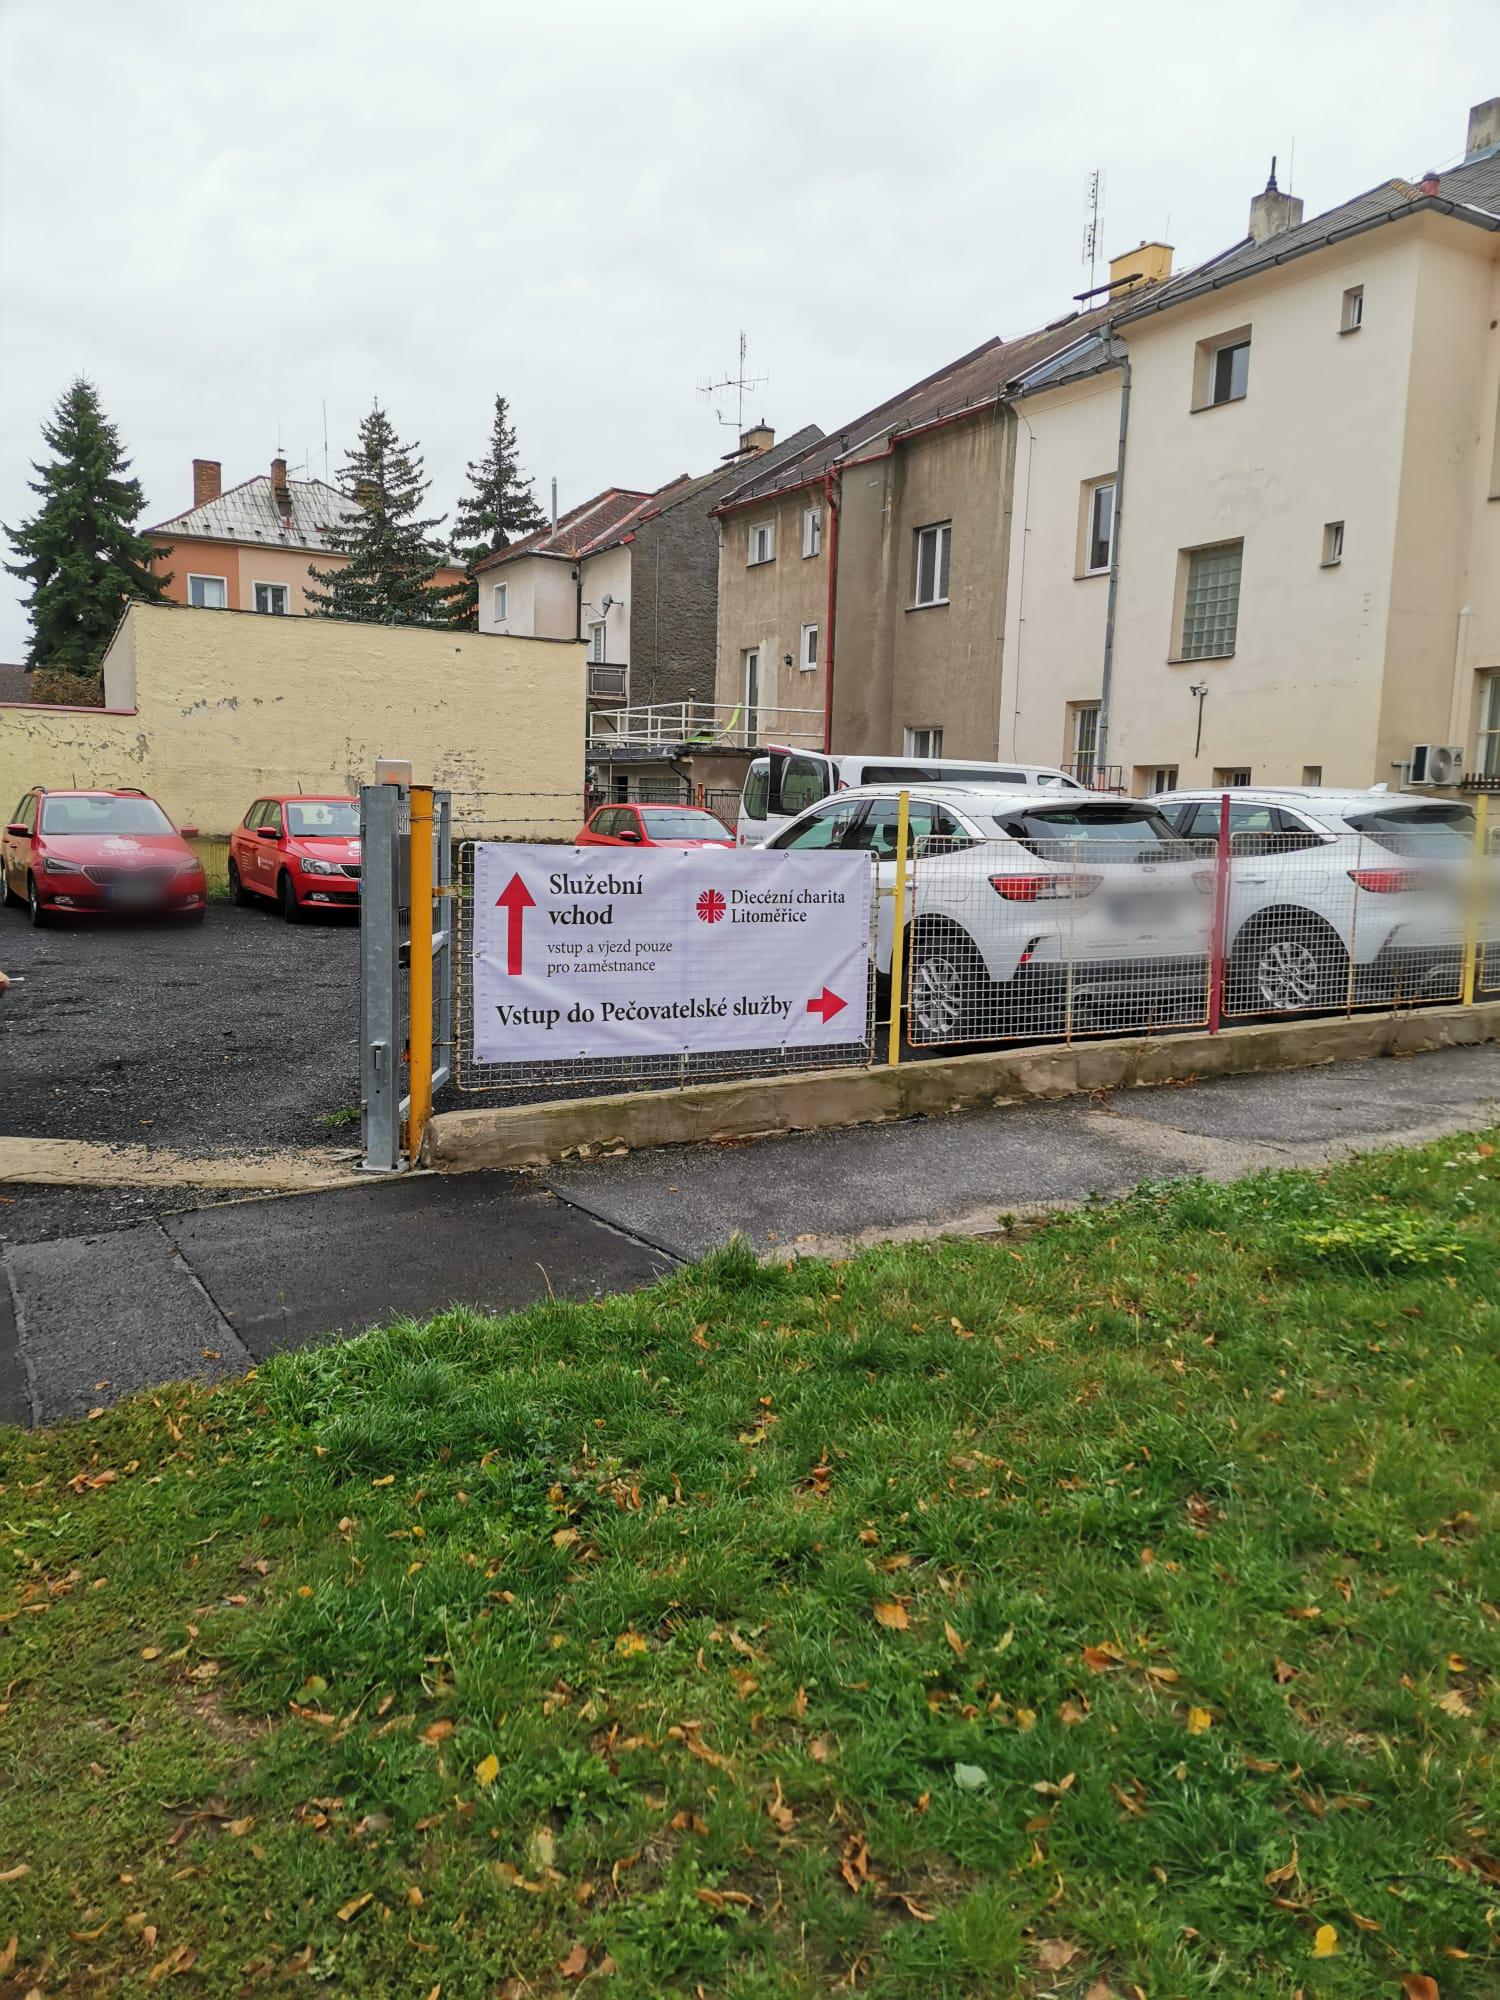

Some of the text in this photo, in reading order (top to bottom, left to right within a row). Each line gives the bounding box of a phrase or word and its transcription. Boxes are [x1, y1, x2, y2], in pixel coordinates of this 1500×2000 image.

[549, 873, 643, 895] Služební
[731, 889, 846, 905] Diecézní charita
[548, 904, 613, 925] vchod
[731, 908, 807, 924] Litoměřice
[547, 939, 673, 956] vstup a vjezd pouze
[547, 959, 656, 976] pro zaměstnance
[495, 994, 793, 1030] Vstup do Pečovatelské služby
